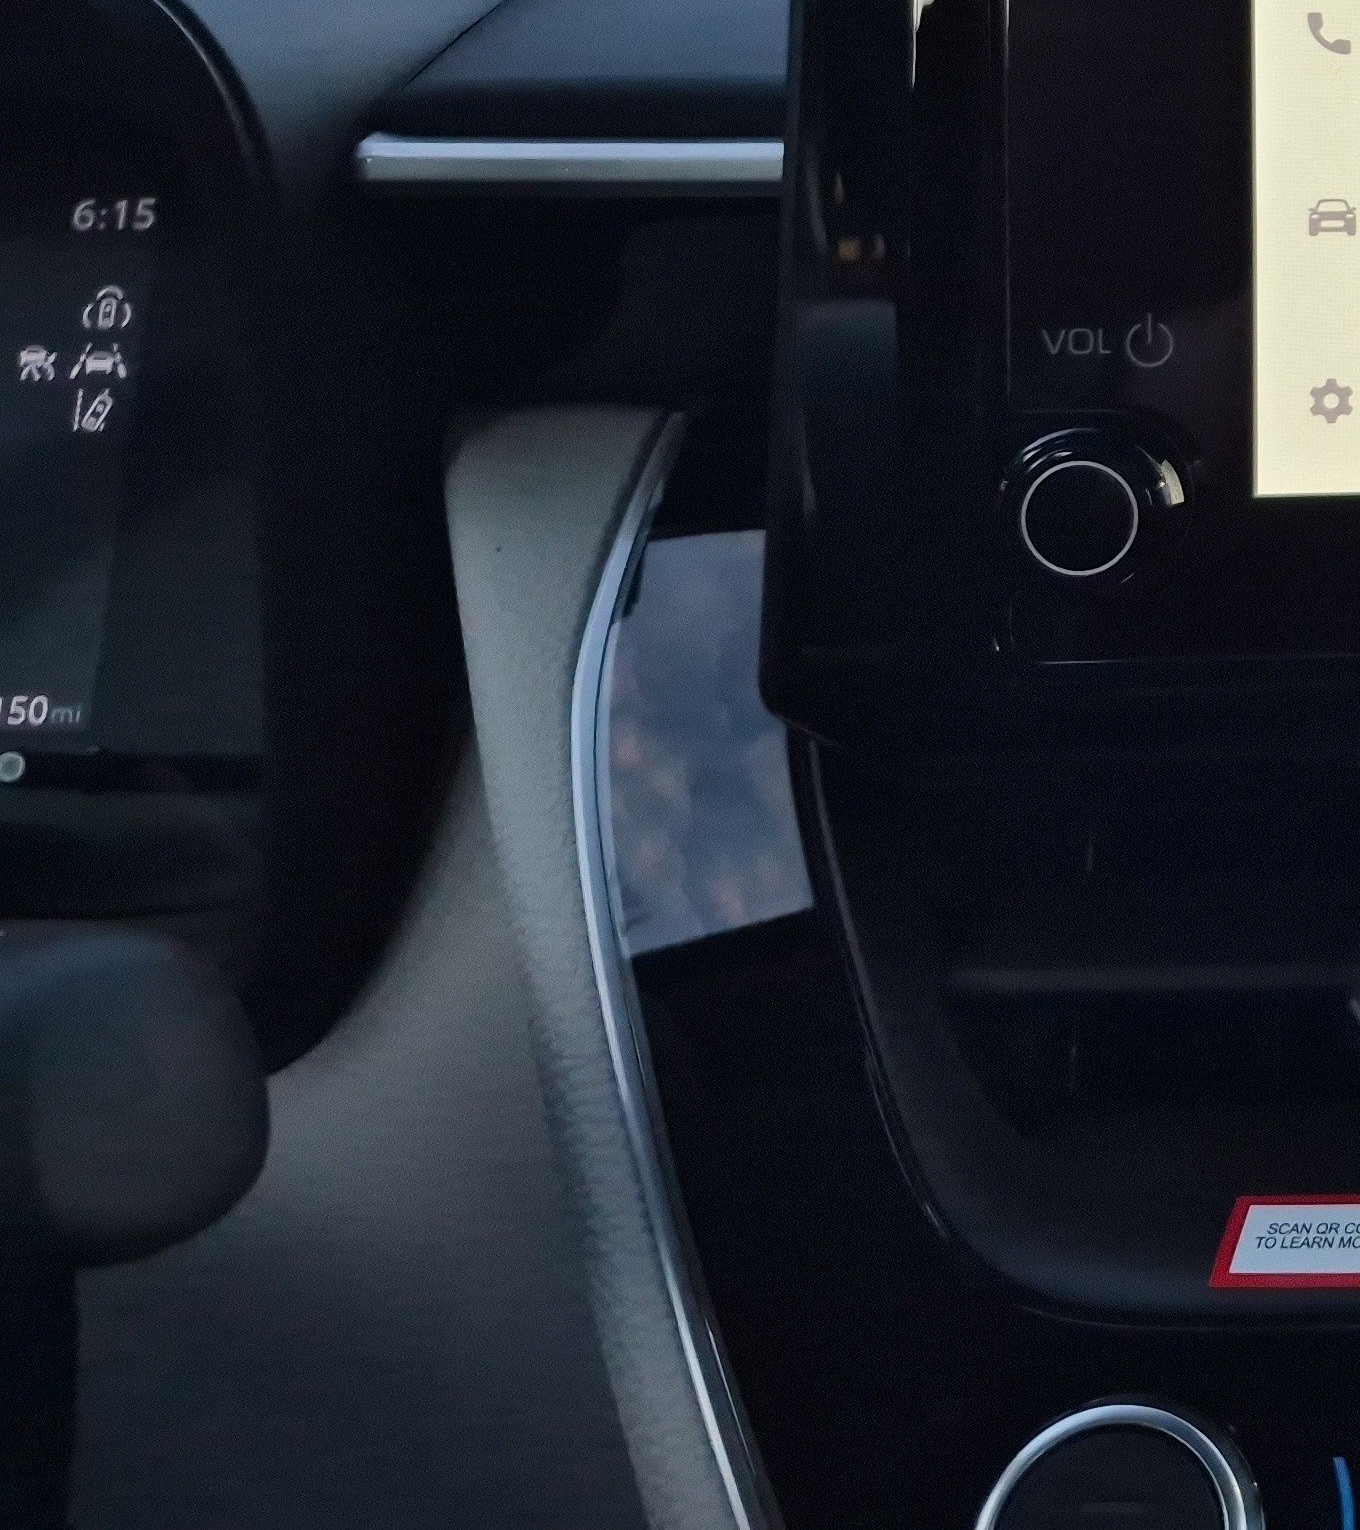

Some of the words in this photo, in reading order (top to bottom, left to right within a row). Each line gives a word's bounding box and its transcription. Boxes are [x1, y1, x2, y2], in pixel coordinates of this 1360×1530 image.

[72, 196, 158, 232] 6:15
[1041, 327, 1112, 355] VOL
[1266, 1221, 1313, 1236] SCAN
[1315, 1221, 1341, 1235] QR
[1255, 1235, 1278, 1250] TO
[1279, 1235, 1335, 1250] LEARN
